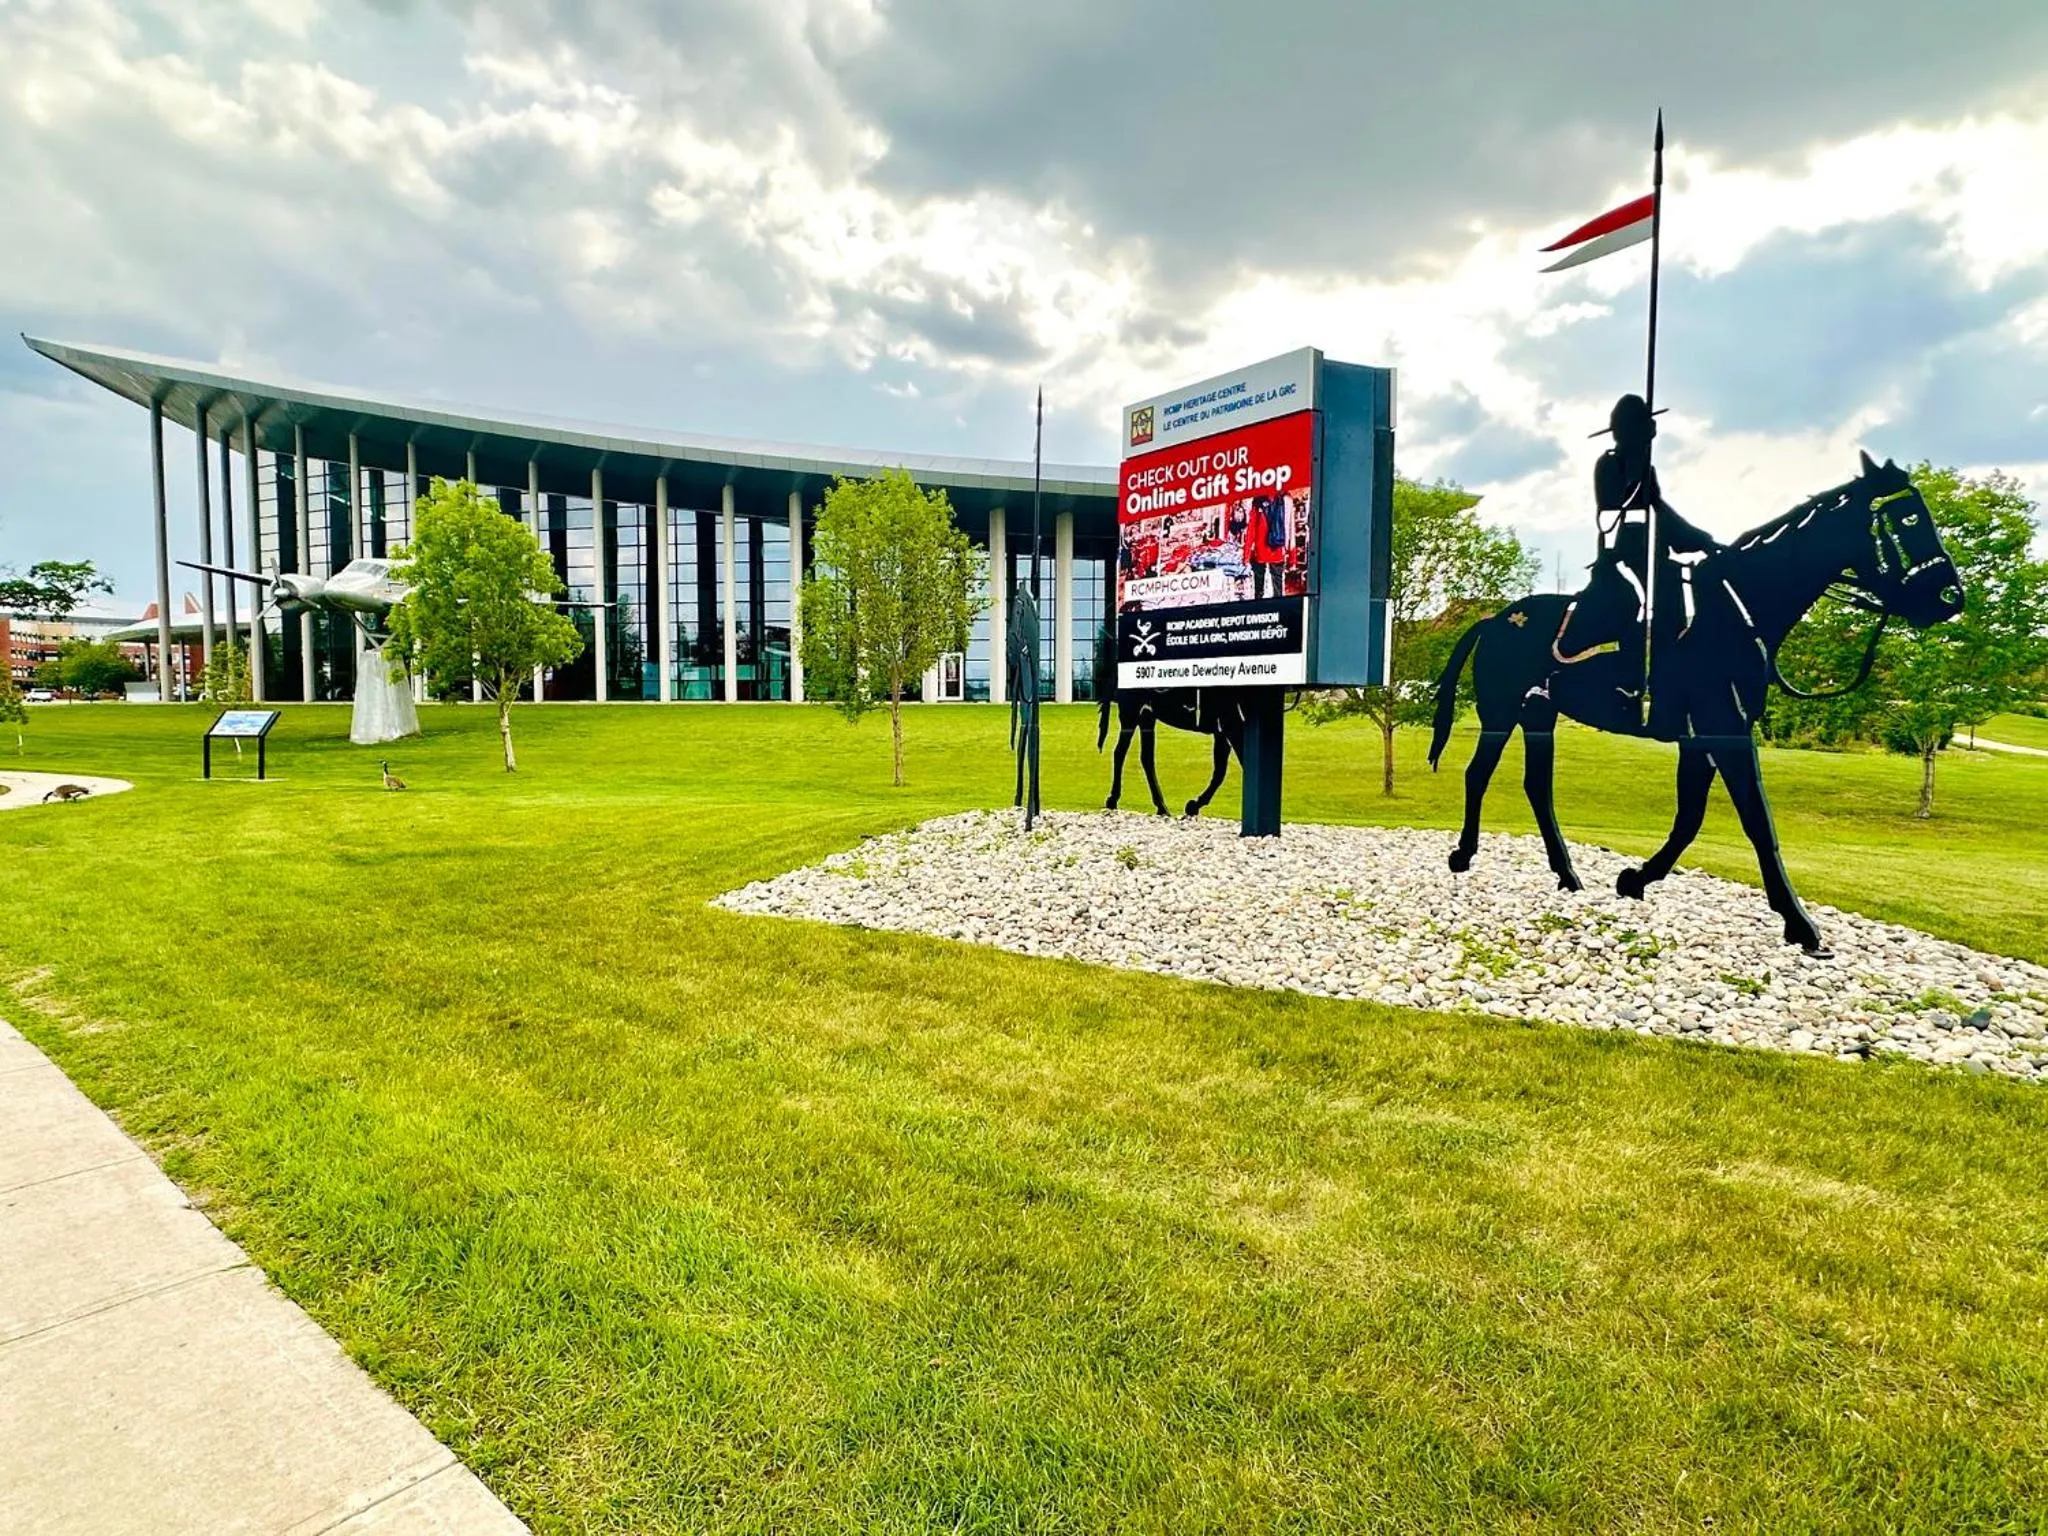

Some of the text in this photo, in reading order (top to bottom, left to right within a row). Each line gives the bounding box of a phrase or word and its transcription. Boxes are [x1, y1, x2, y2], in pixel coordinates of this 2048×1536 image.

[1163, 383, 1297, 431] LE CENTRE DU PATRIMOINE DE LA GRC
[1164, 382, 1246, 416] RCMP HERITAGE CENTRE
[1127, 446, 1249, 491] CHECK OUT OUR
[1126, 464, 1292, 514] Online Gift Shop
[1131, 575, 1211, 596] RCMPHC.COM
[1166, 620, 1186, 631] RCMP
[1221, 614, 1245, 627] DEPOT
[1246, 612, 1279, 624] DIVISION
[1166, 632, 1188, 646] ÉCOLE
[1189, 634, 1199, 645] DE
[1199, 633, 1210, 644] LA
[1228, 629, 1260, 642] DIVISION
[1261, 624, 1288, 640] DÉPÔT
[1136, 661, 1277, 679] 5907 avenue Dewdney Avenue
